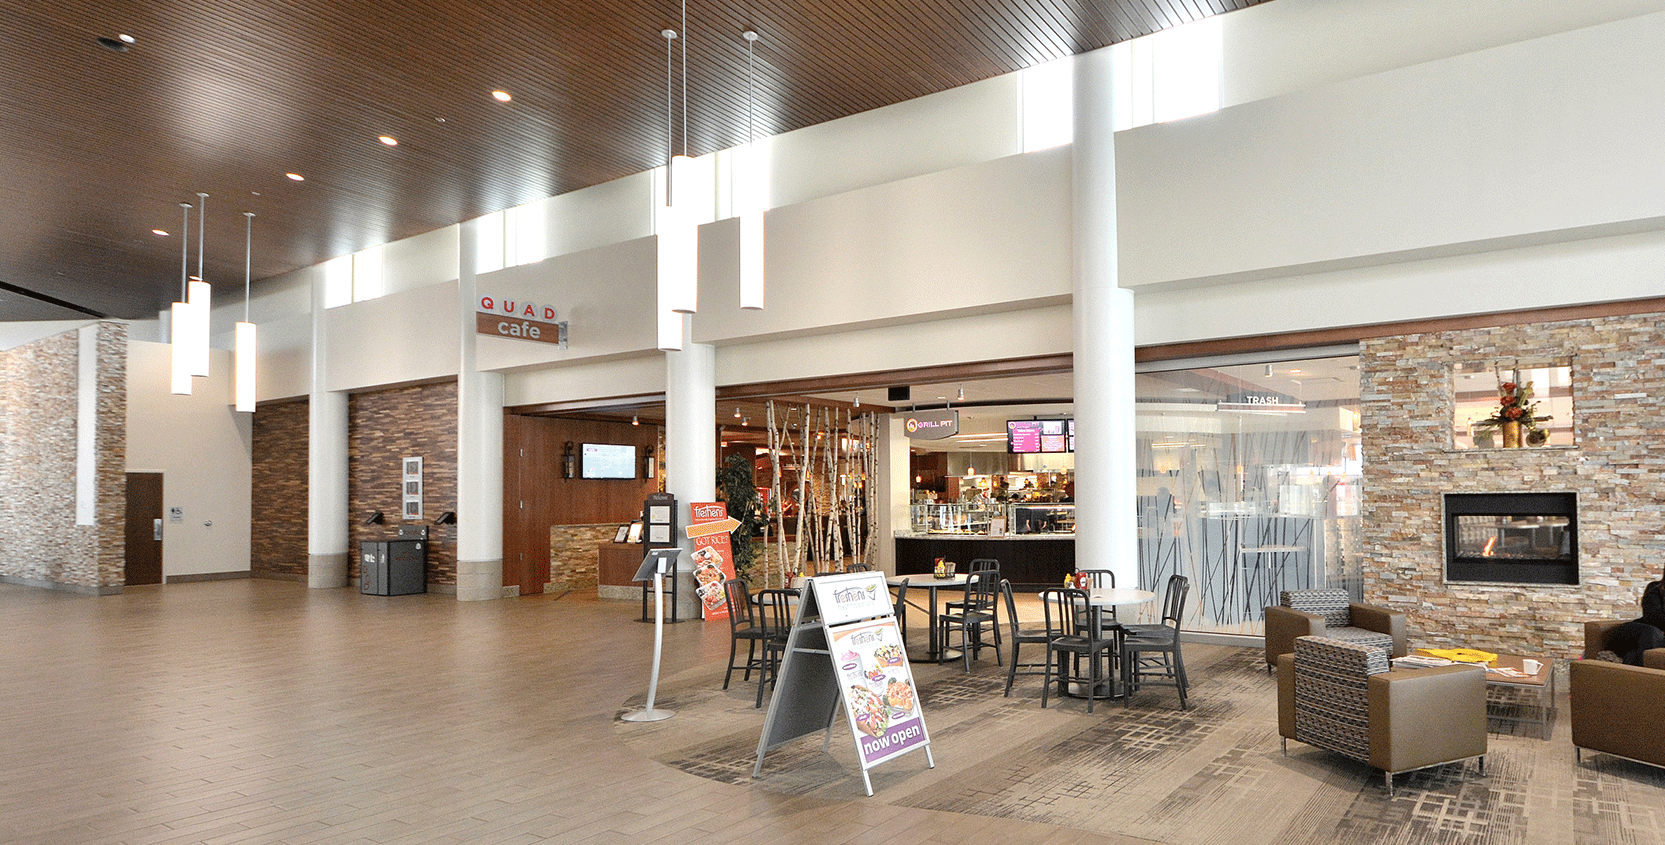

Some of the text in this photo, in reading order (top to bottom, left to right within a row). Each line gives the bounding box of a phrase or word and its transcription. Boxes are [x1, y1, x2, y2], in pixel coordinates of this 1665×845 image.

[481, 297, 555, 319] QUAD
[497, 321, 541, 339] cafe
[1246, 396, 1279, 404] TRASH
[917, 421, 940, 429] GRILL
[863, 724, 920, 756] now open
